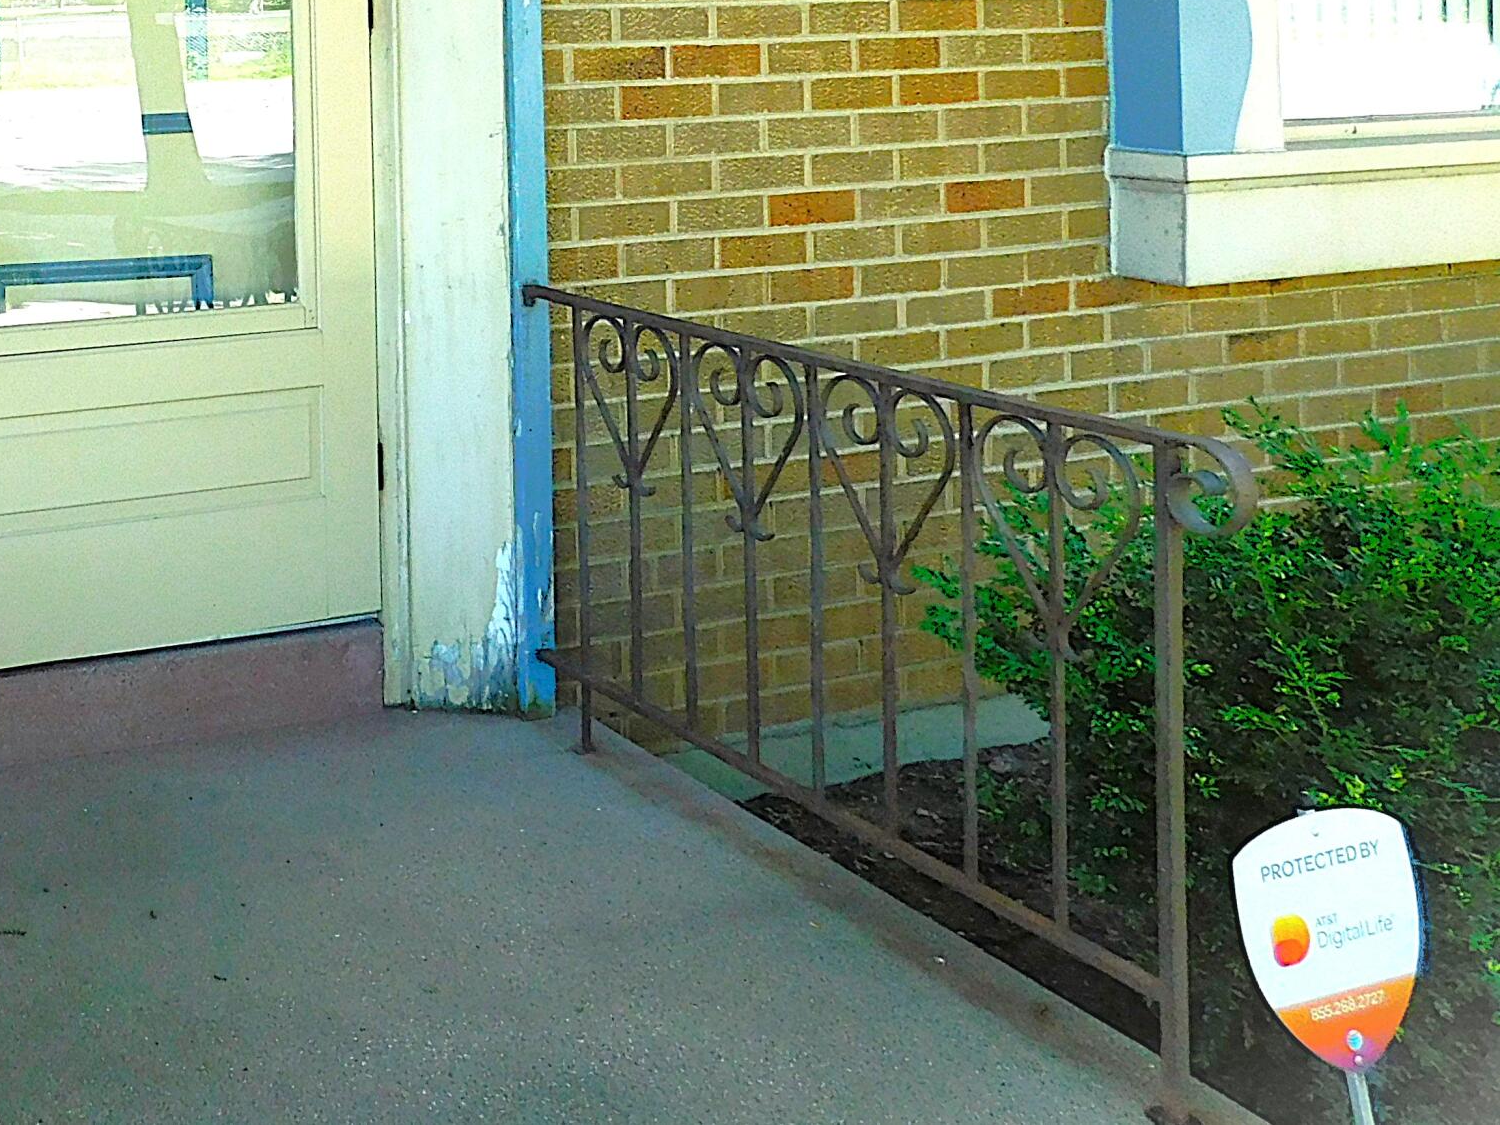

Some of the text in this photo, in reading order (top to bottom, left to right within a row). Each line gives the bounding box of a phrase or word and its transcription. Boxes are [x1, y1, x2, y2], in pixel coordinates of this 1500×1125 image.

[1260, 839, 1379, 882] PROTECTED BY
[1316, 917, 1394, 949] Digital Life
